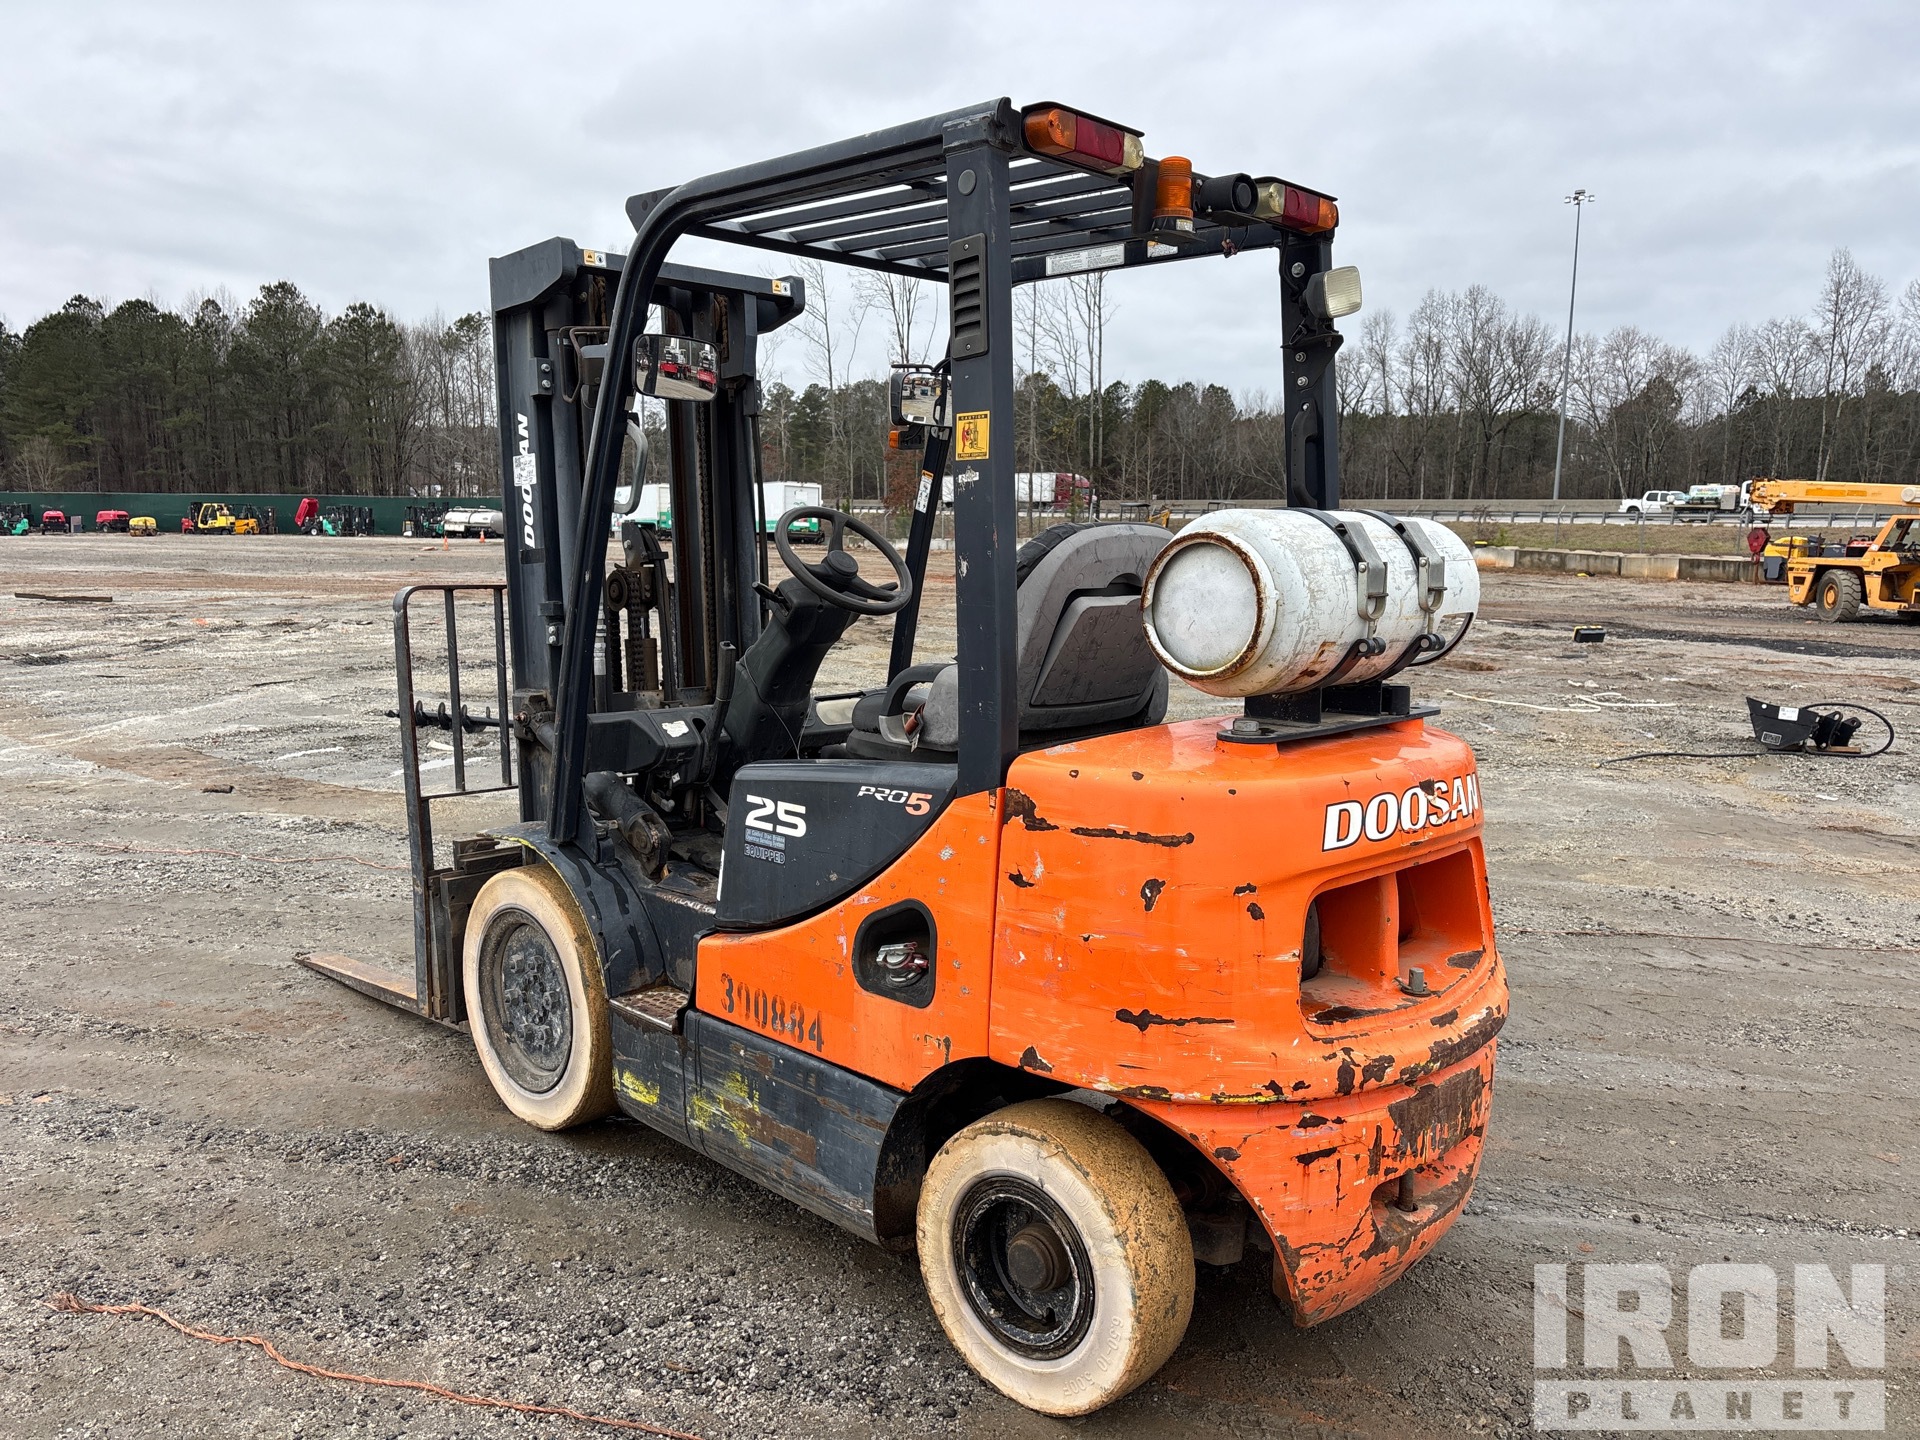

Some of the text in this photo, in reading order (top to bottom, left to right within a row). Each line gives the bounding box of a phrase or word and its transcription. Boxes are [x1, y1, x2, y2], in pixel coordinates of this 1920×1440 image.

[517, 412, 535, 549] DOOAN
[745, 794, 807, 837] 25
[857, 785, 933, 816] PRO5
[1322, 772, 1480, 852] DOOSAN
[1095, 1315, 1125, 1373] 6.50-10
